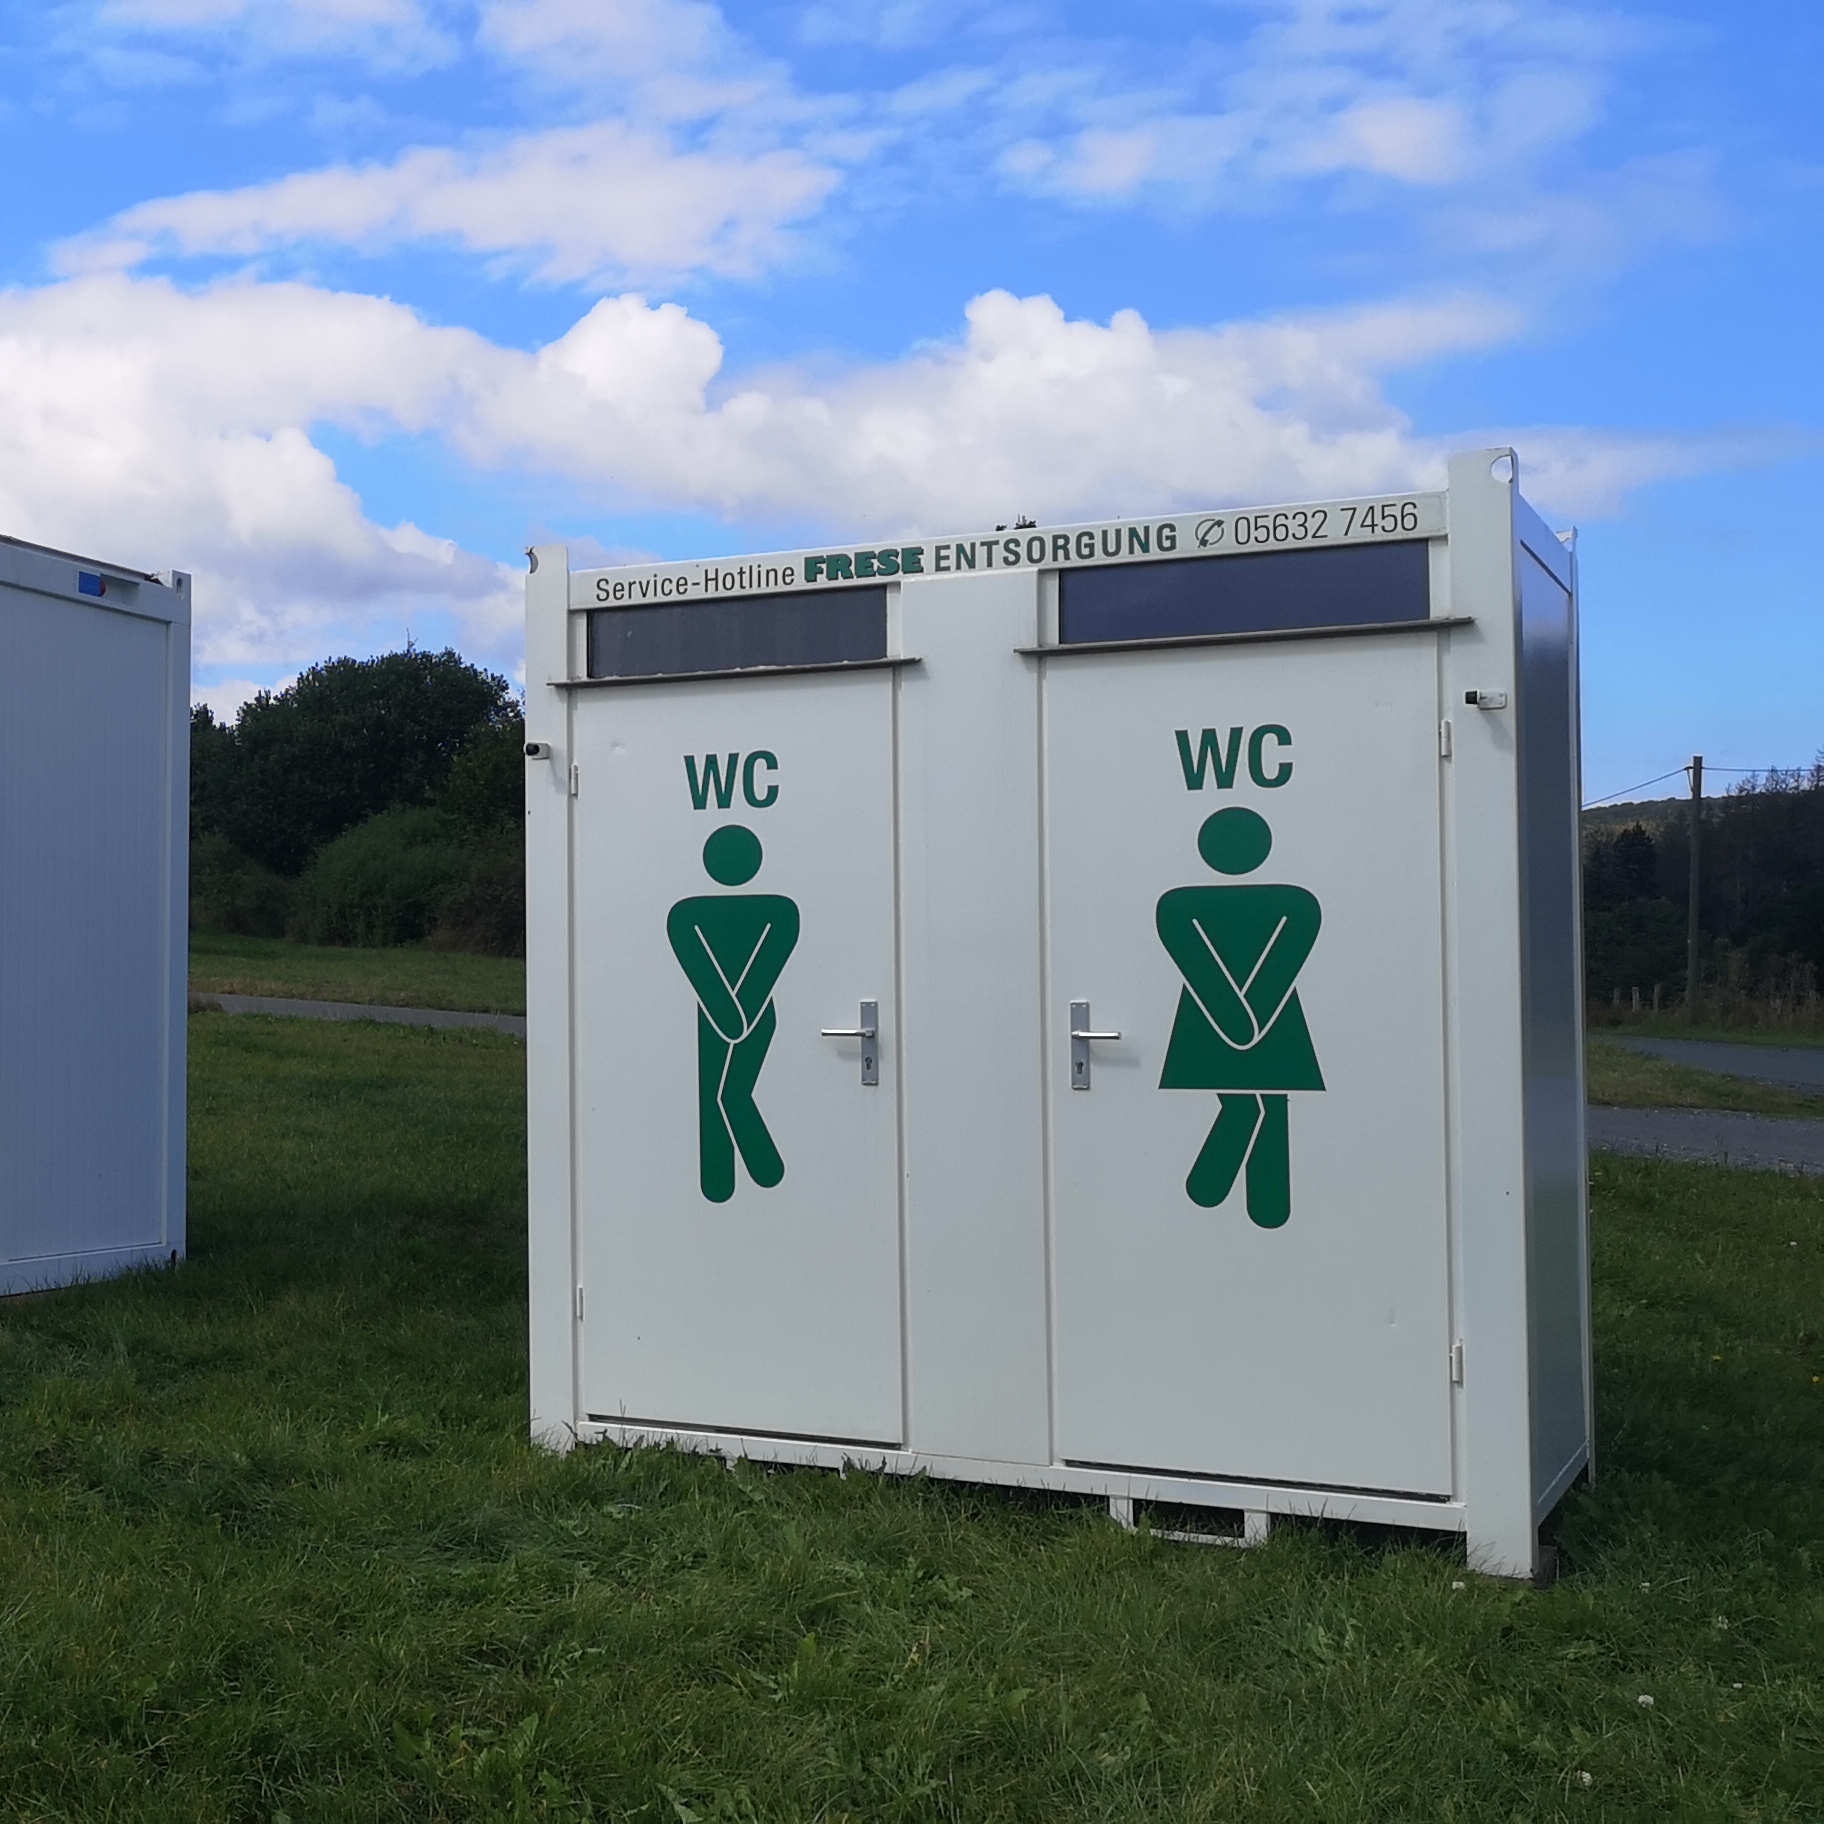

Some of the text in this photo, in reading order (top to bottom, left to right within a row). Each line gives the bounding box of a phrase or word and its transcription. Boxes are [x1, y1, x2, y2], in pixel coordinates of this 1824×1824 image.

[595, 501, 1419, 602] Service-Hotline FRESE ENTSORGUNG 05632 7456
[684, 750, 780, 811] WC
[1174, 723, 1294, 791] WC
